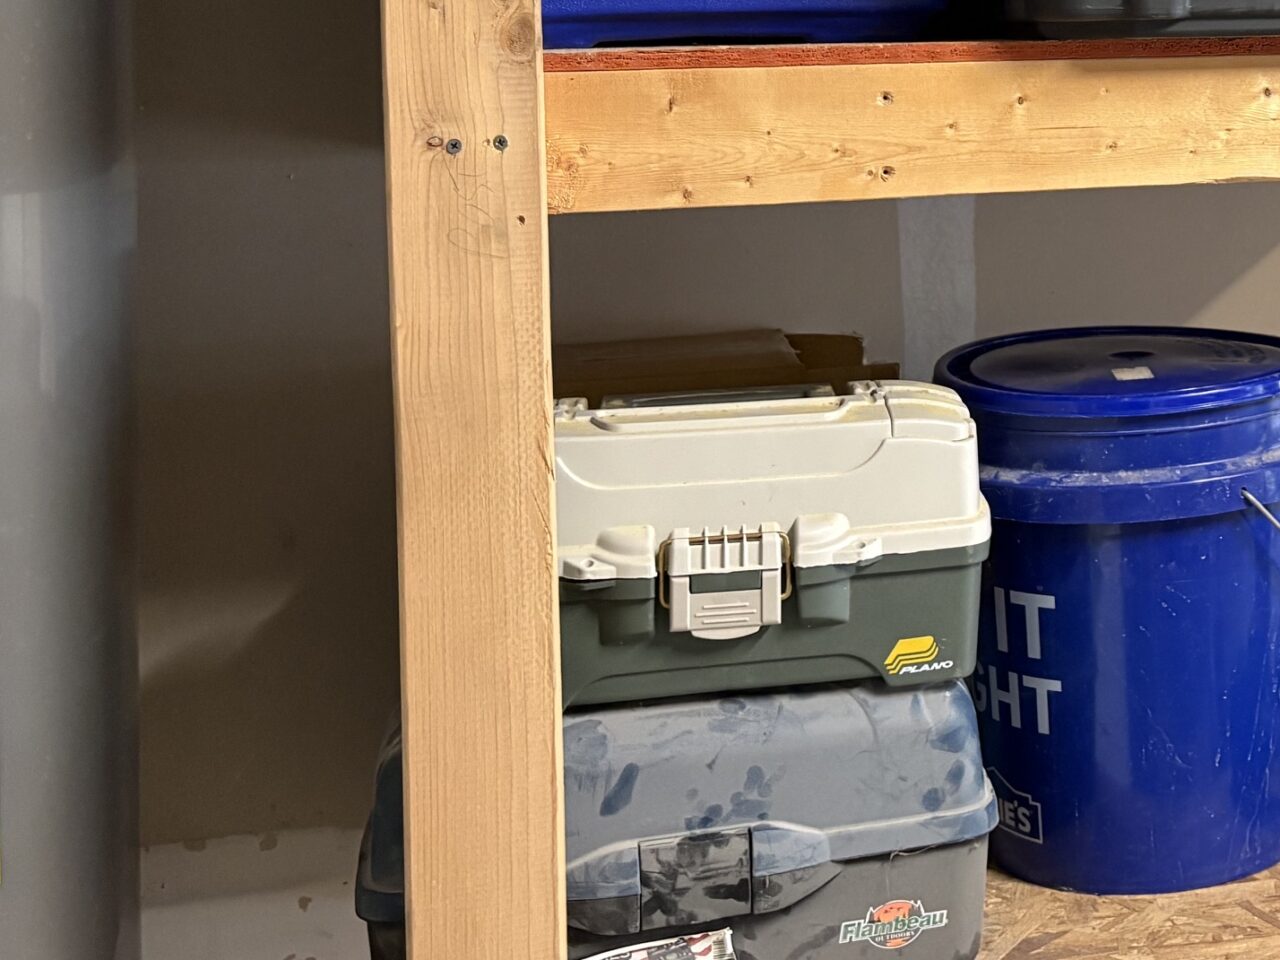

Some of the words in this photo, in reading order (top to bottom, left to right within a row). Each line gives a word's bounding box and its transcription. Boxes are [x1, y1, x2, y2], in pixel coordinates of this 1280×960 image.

[993, 586, 1056, 660] IT
[899, 660, 954, 675] PLANO
[999, 798, 1032, 833] E'S
[840, 909, 947, 943] Flambeau
